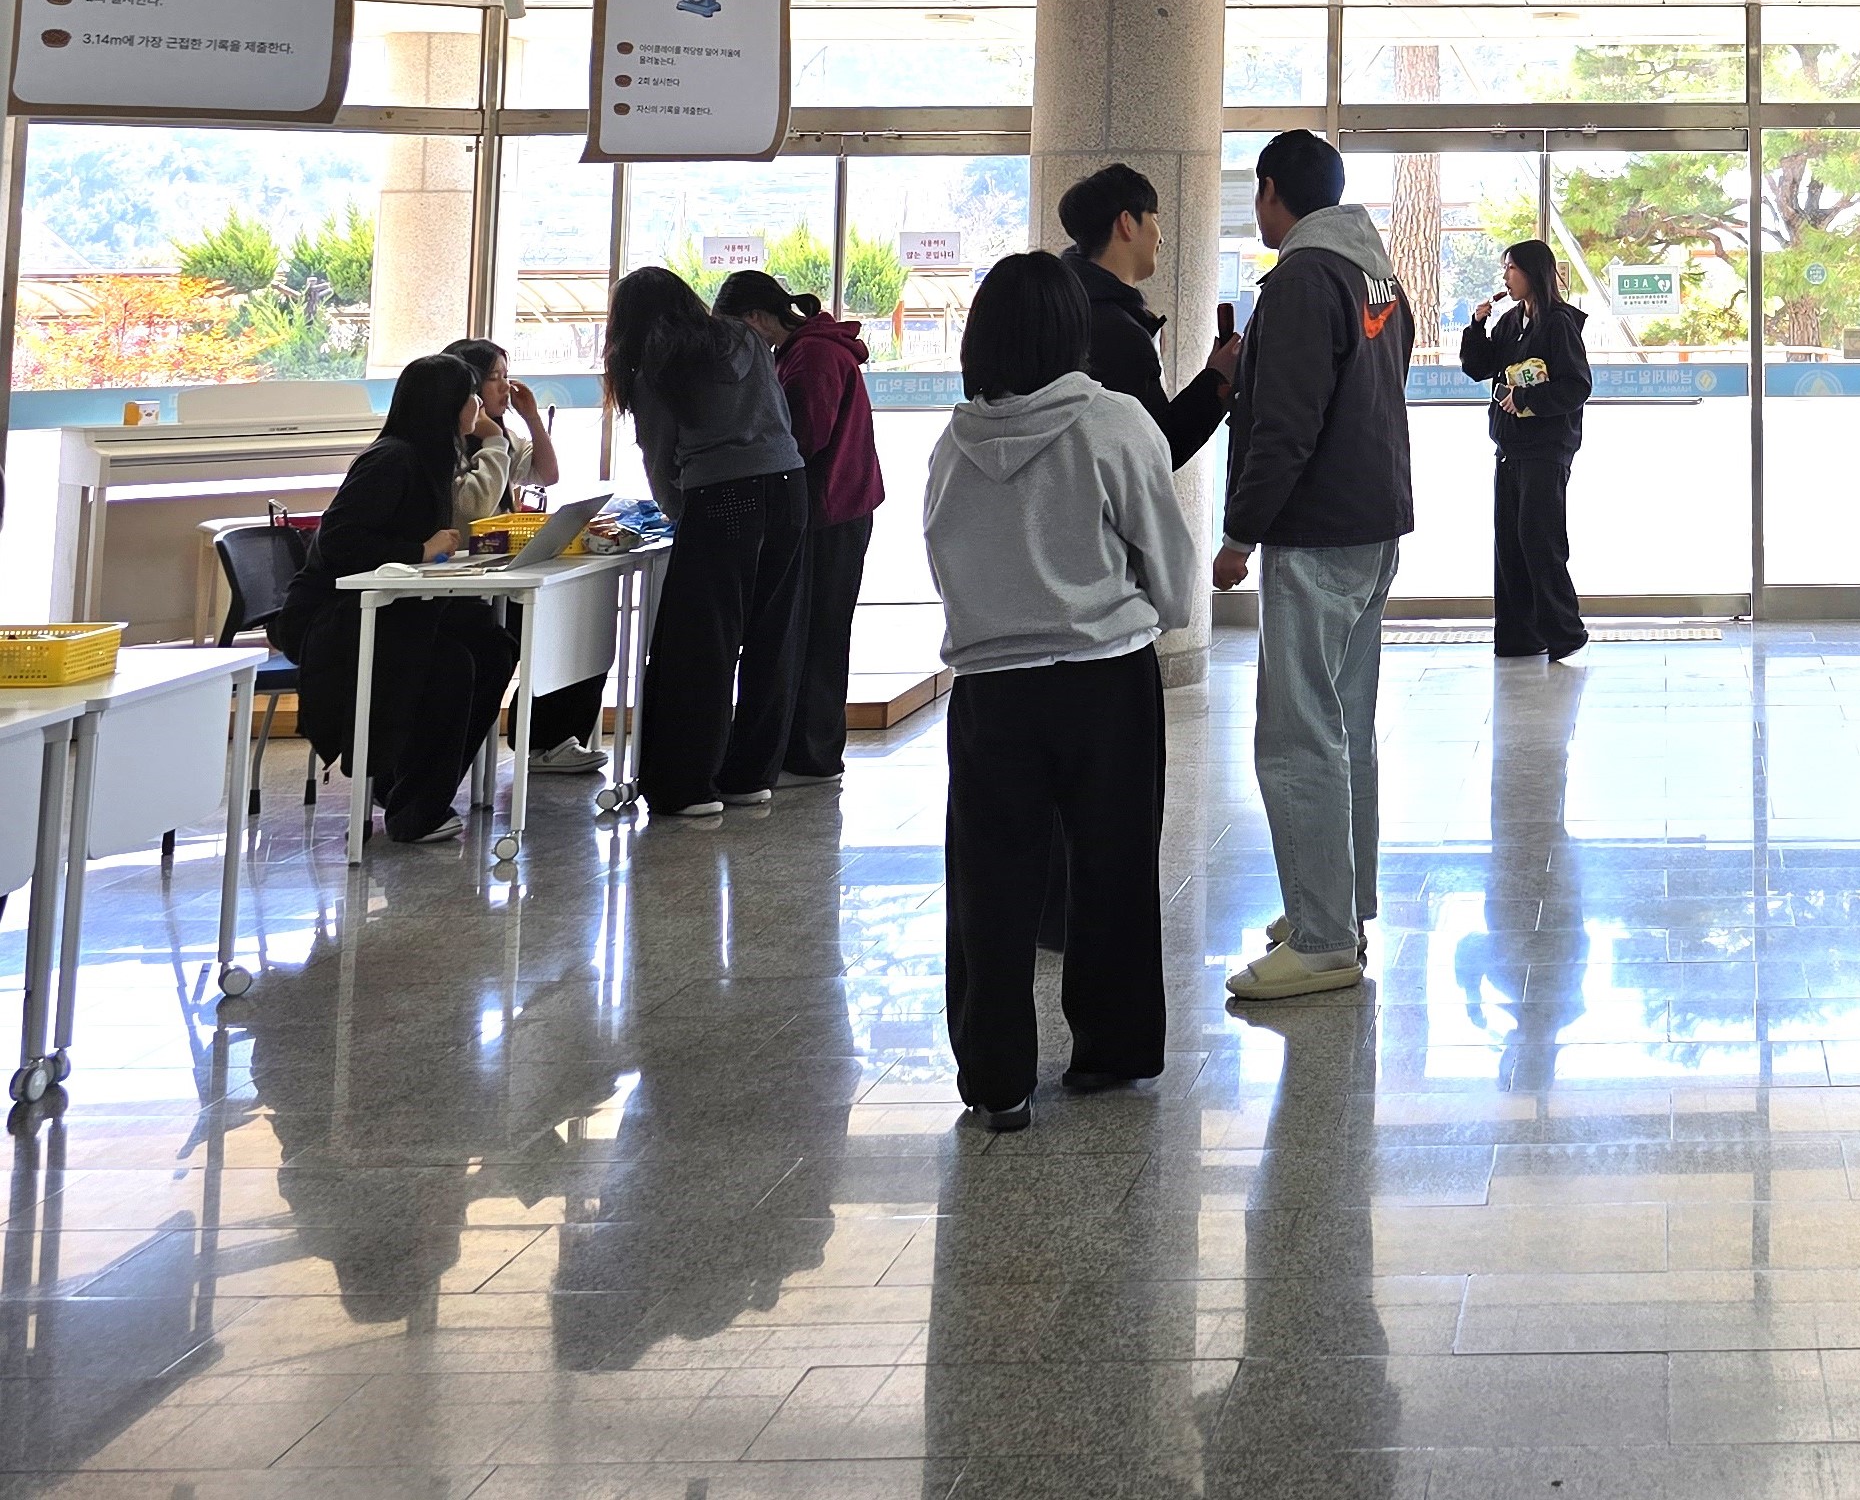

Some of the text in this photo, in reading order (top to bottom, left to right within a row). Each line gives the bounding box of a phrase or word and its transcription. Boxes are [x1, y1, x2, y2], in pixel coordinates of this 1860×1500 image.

[82, 33, 294, 55] 3.14m에 가장 근접한 기록을 제출한다.
